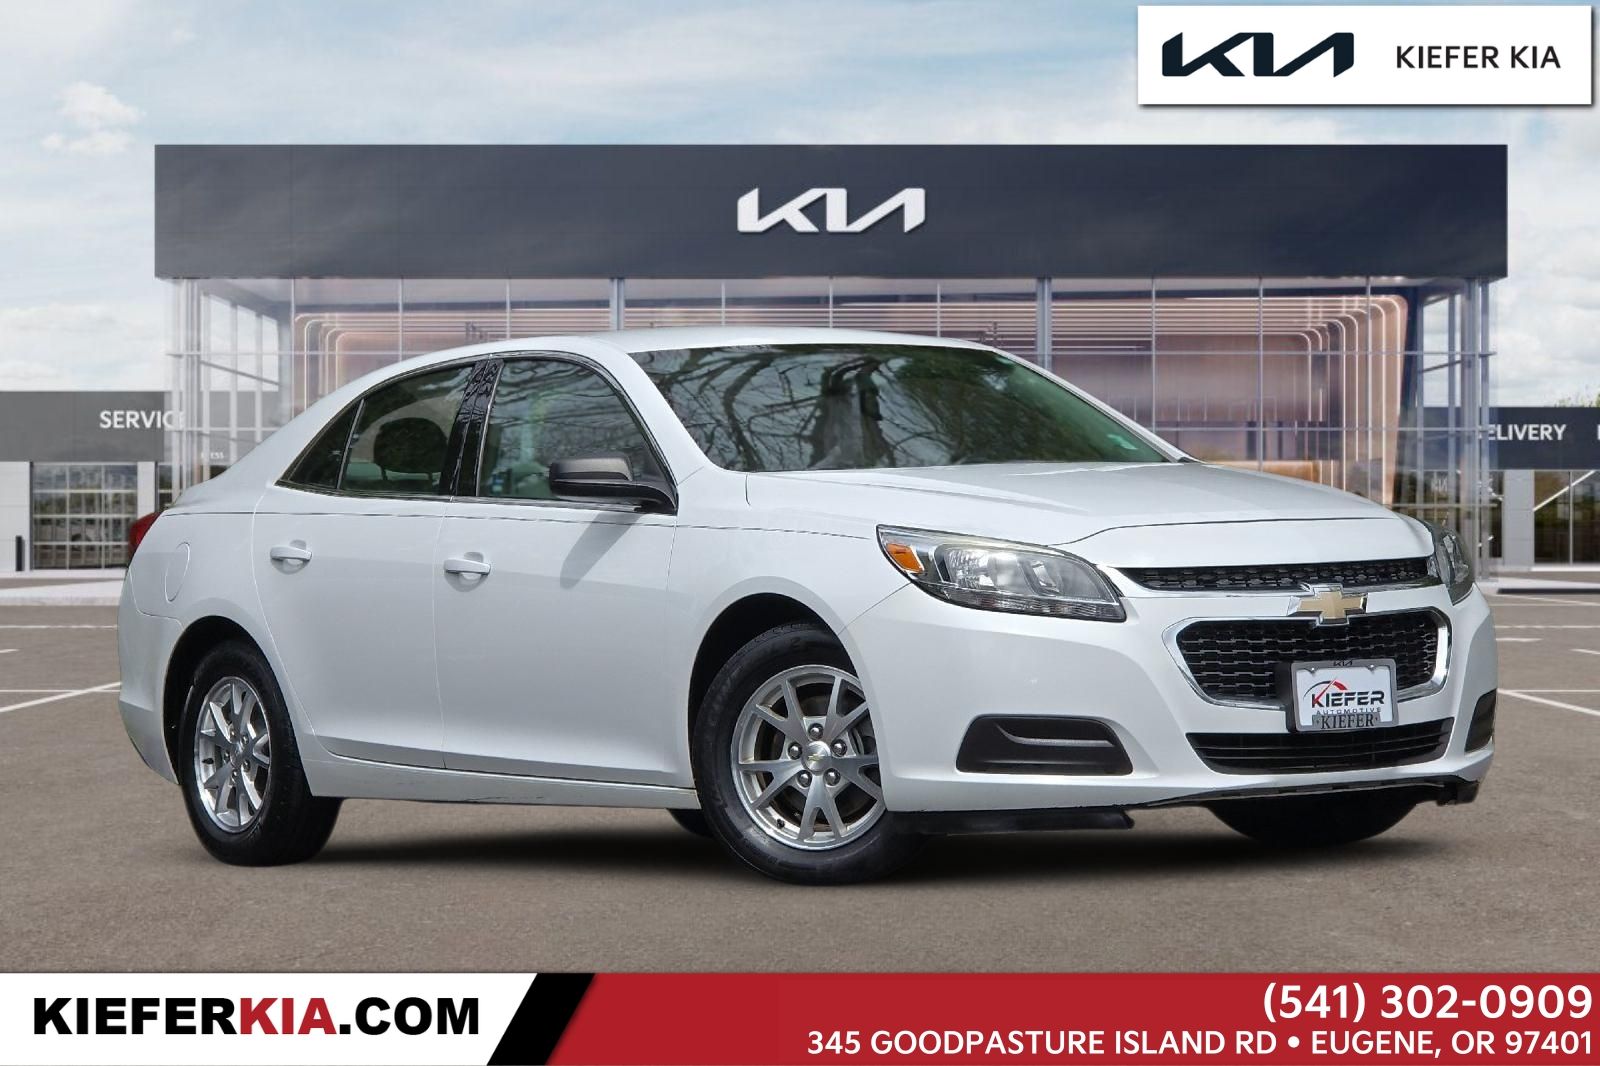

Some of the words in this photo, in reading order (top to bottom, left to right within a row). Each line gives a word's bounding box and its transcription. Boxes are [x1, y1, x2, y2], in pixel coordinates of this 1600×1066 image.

[737, 187, 926, 233] KIA
[1476, 424, 1566, 440] ELIVERY
[1311, 682, 1385, 708] KIEFER
[1320, 712, 1375, 729] KIEFER
